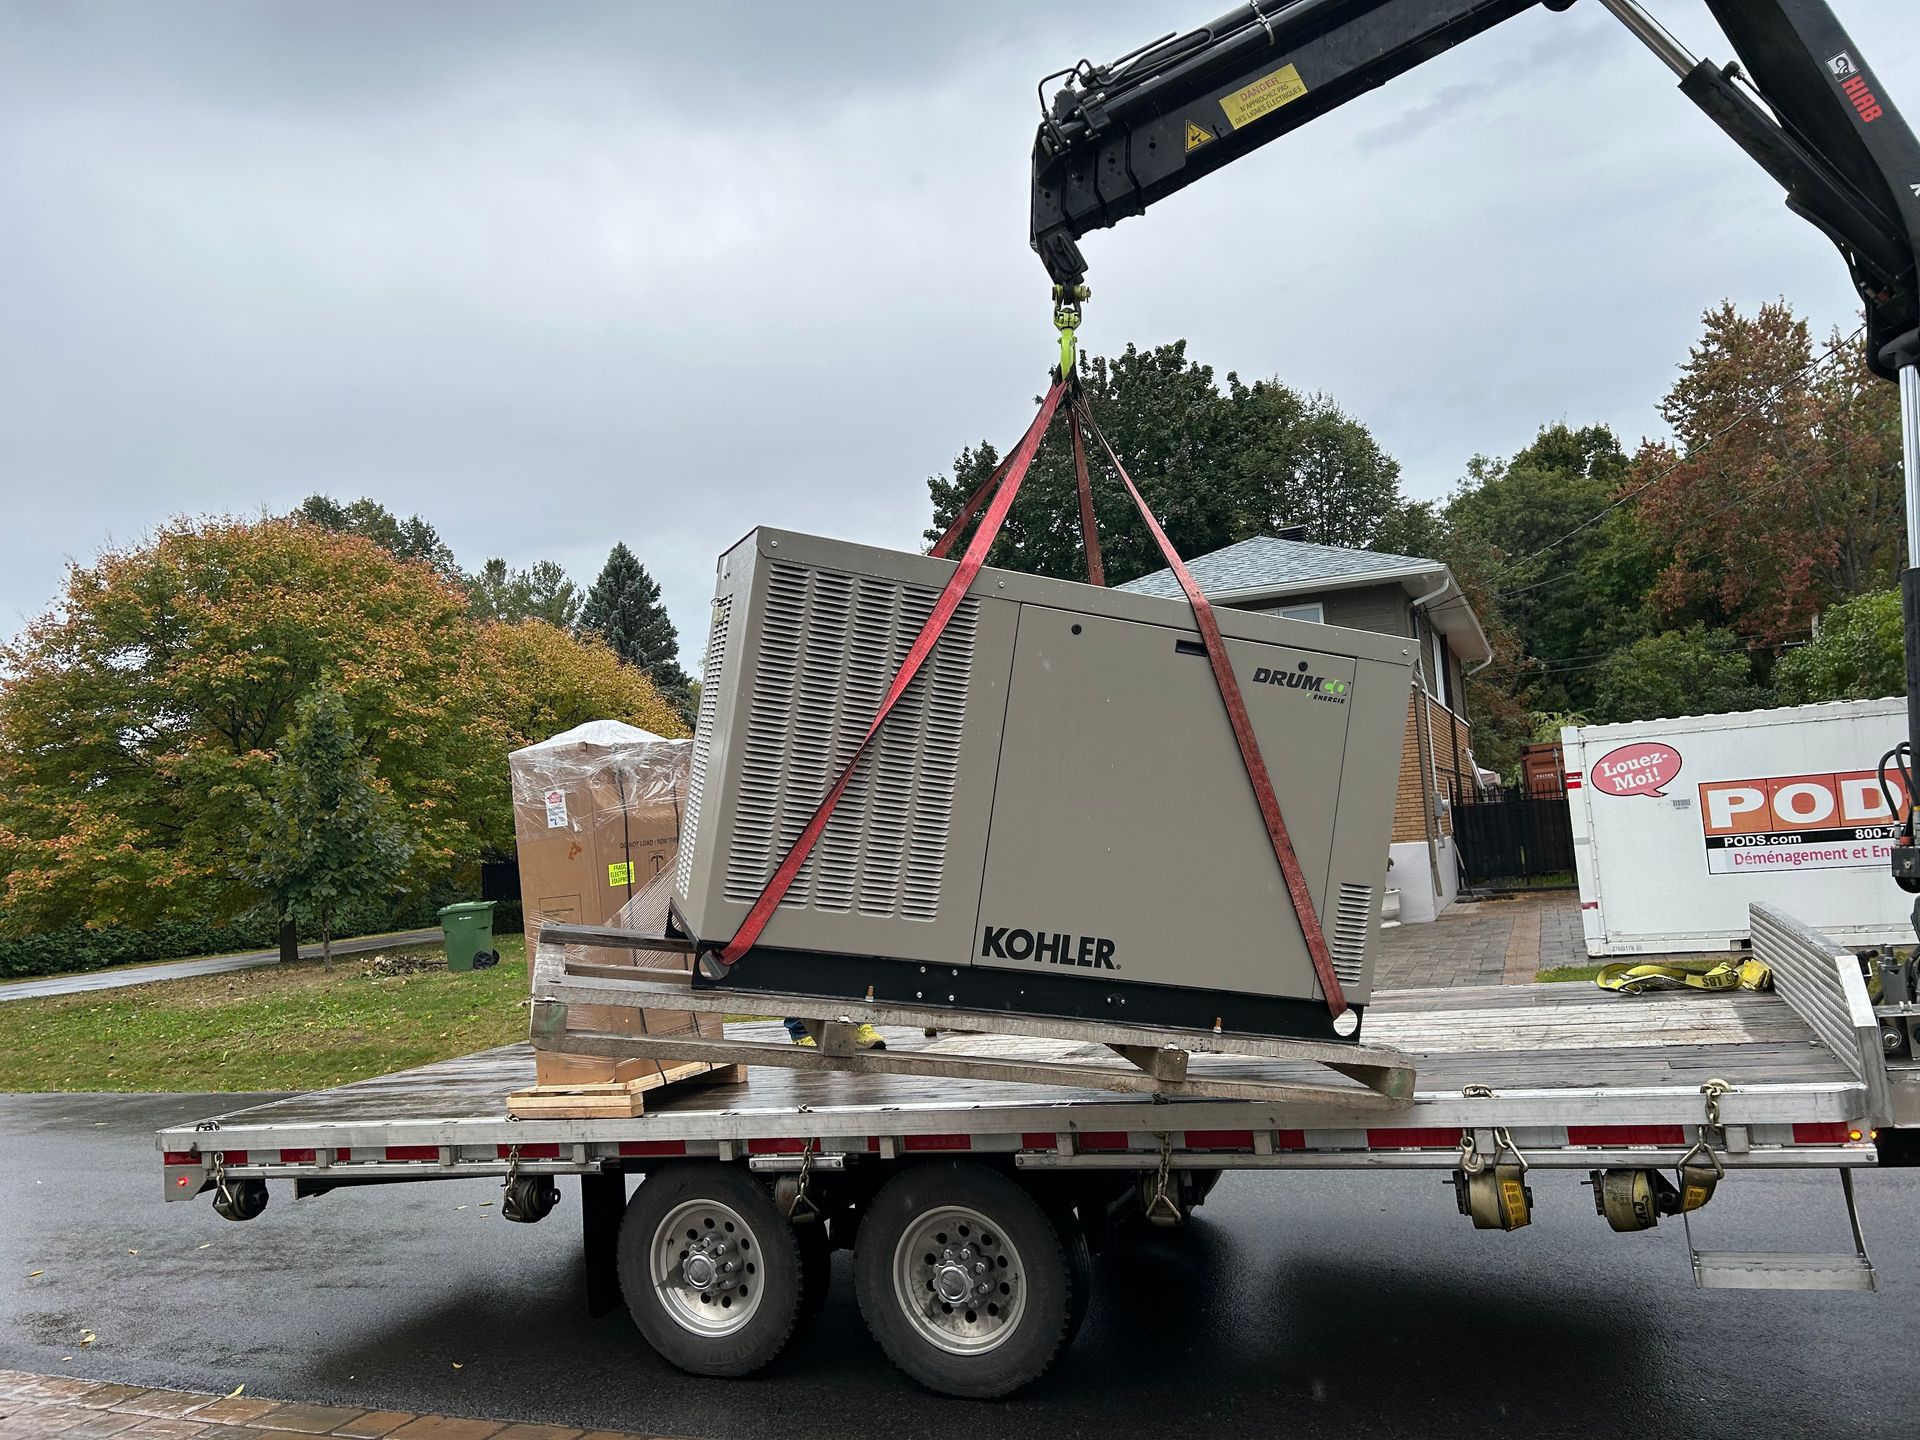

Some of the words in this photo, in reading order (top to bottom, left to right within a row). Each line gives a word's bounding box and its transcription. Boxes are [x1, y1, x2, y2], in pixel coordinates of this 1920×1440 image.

[1241, 77, 1279, 101] DANGER
[1277, 83, 1289, 92] PAS
[1842, 75, 1883, 123] HIAB
[1235, 114, 1247, 125] DES
[1246, 104, 1267, 119] LIGNES
[1601, 752, 1668, 777] Louez-
[1612, 767, 1660, 791] Moi!
[1706, 779, 1903, 828] POD
[1724, 834, 1802, 848] PODS.com
[1855, 828, 1904, 840] 800-7
[1734, 847, 1848, 866] Déménagement
[1852, 846, 1867, 857] et
[981, 925, 1116, 970] KOHLER
